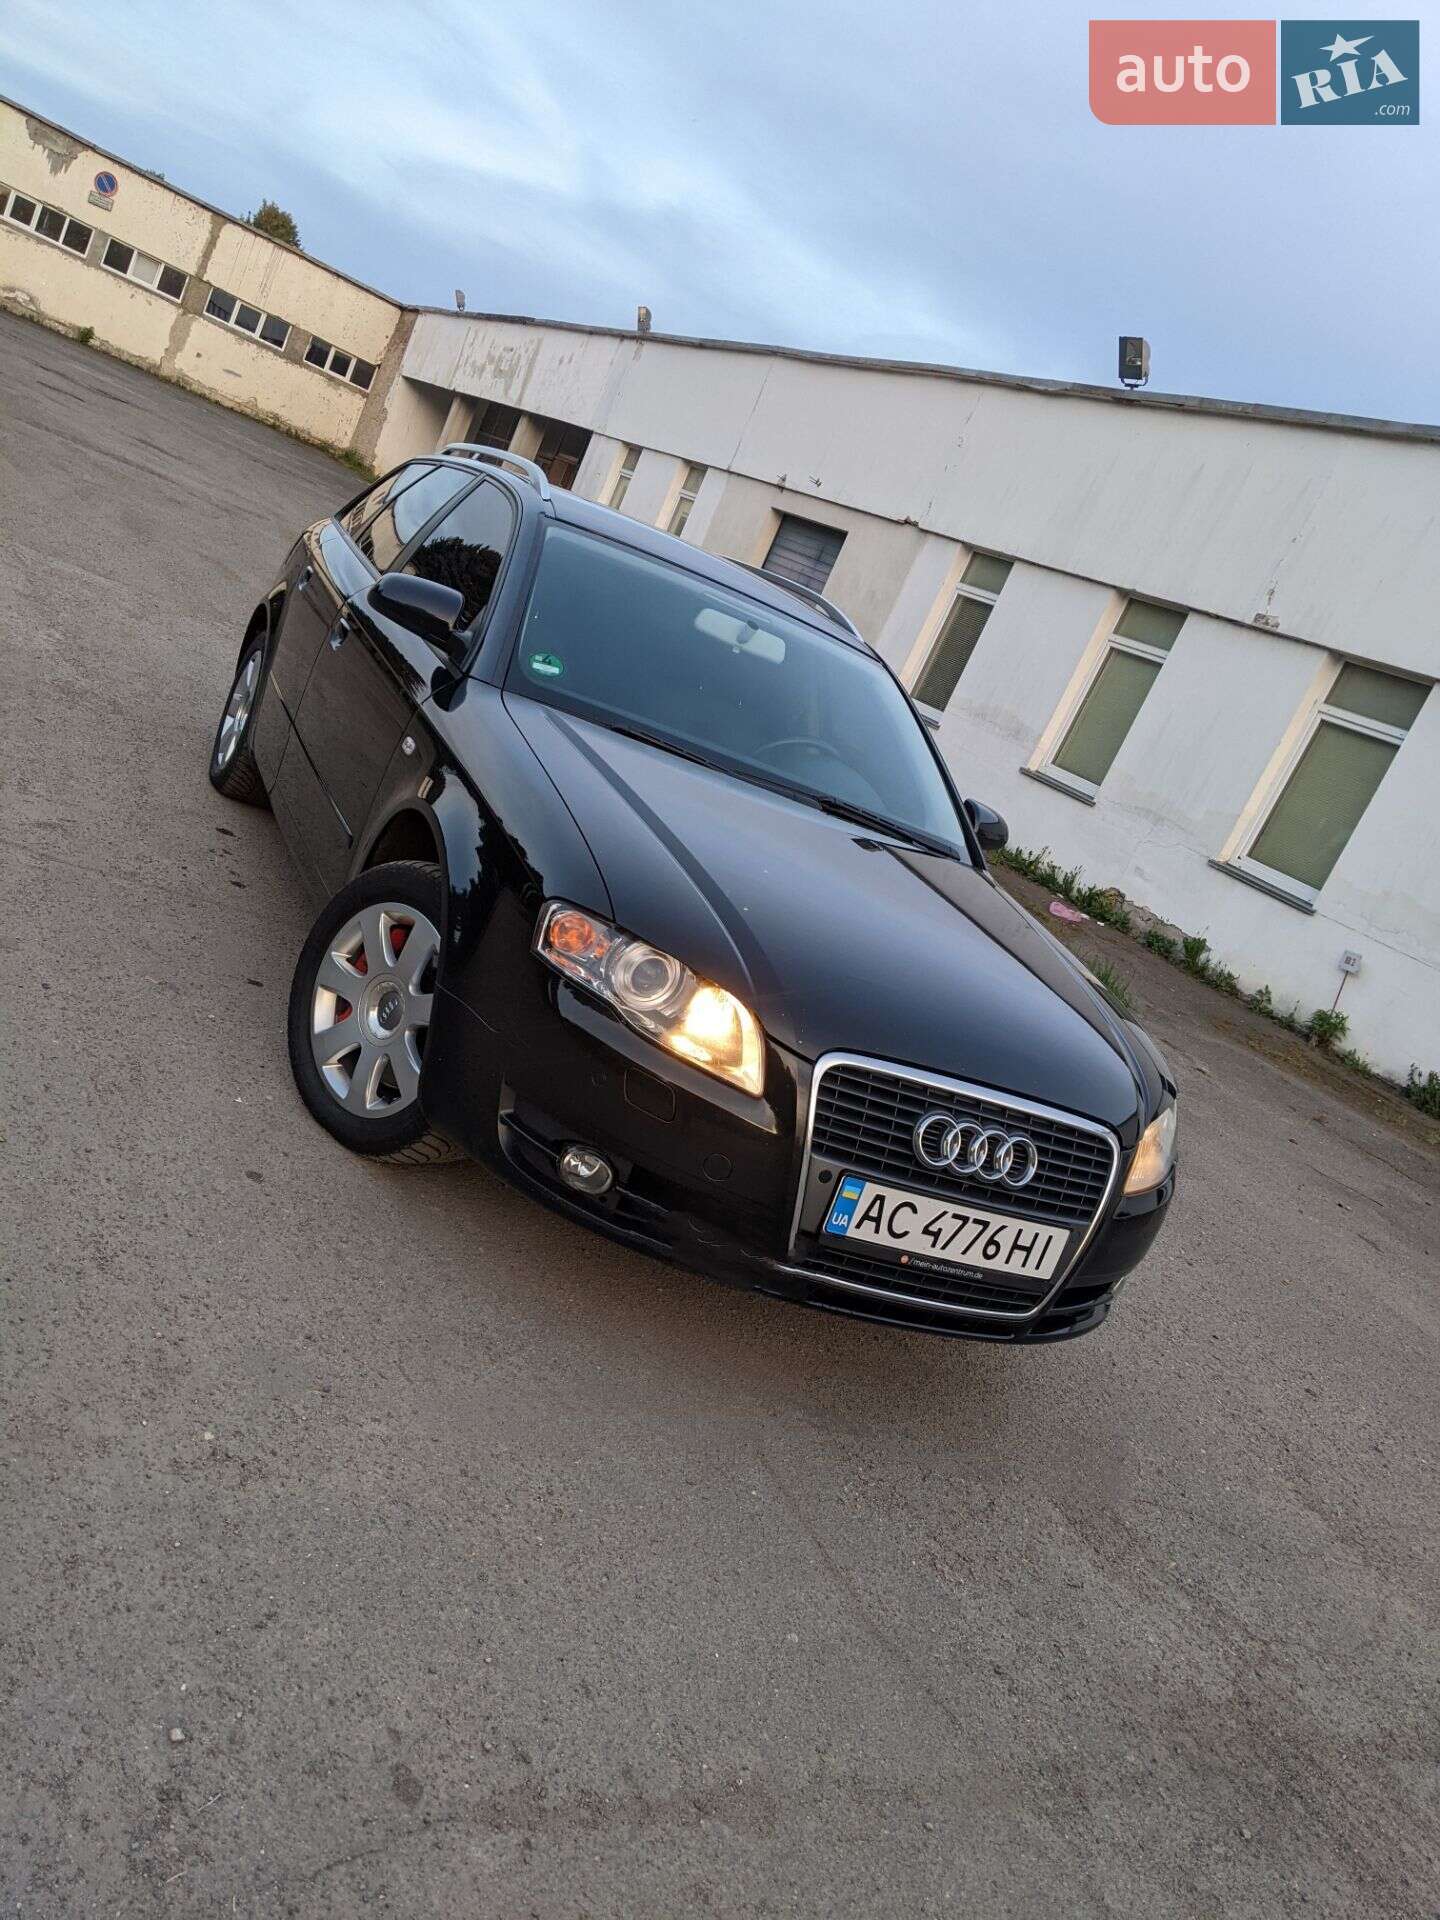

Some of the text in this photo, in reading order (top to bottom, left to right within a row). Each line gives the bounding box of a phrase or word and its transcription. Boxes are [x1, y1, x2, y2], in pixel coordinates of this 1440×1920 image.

[832, 1212, 849, 1228] UA
[855, 1194, 1053, 1271] AC 4776 HI
